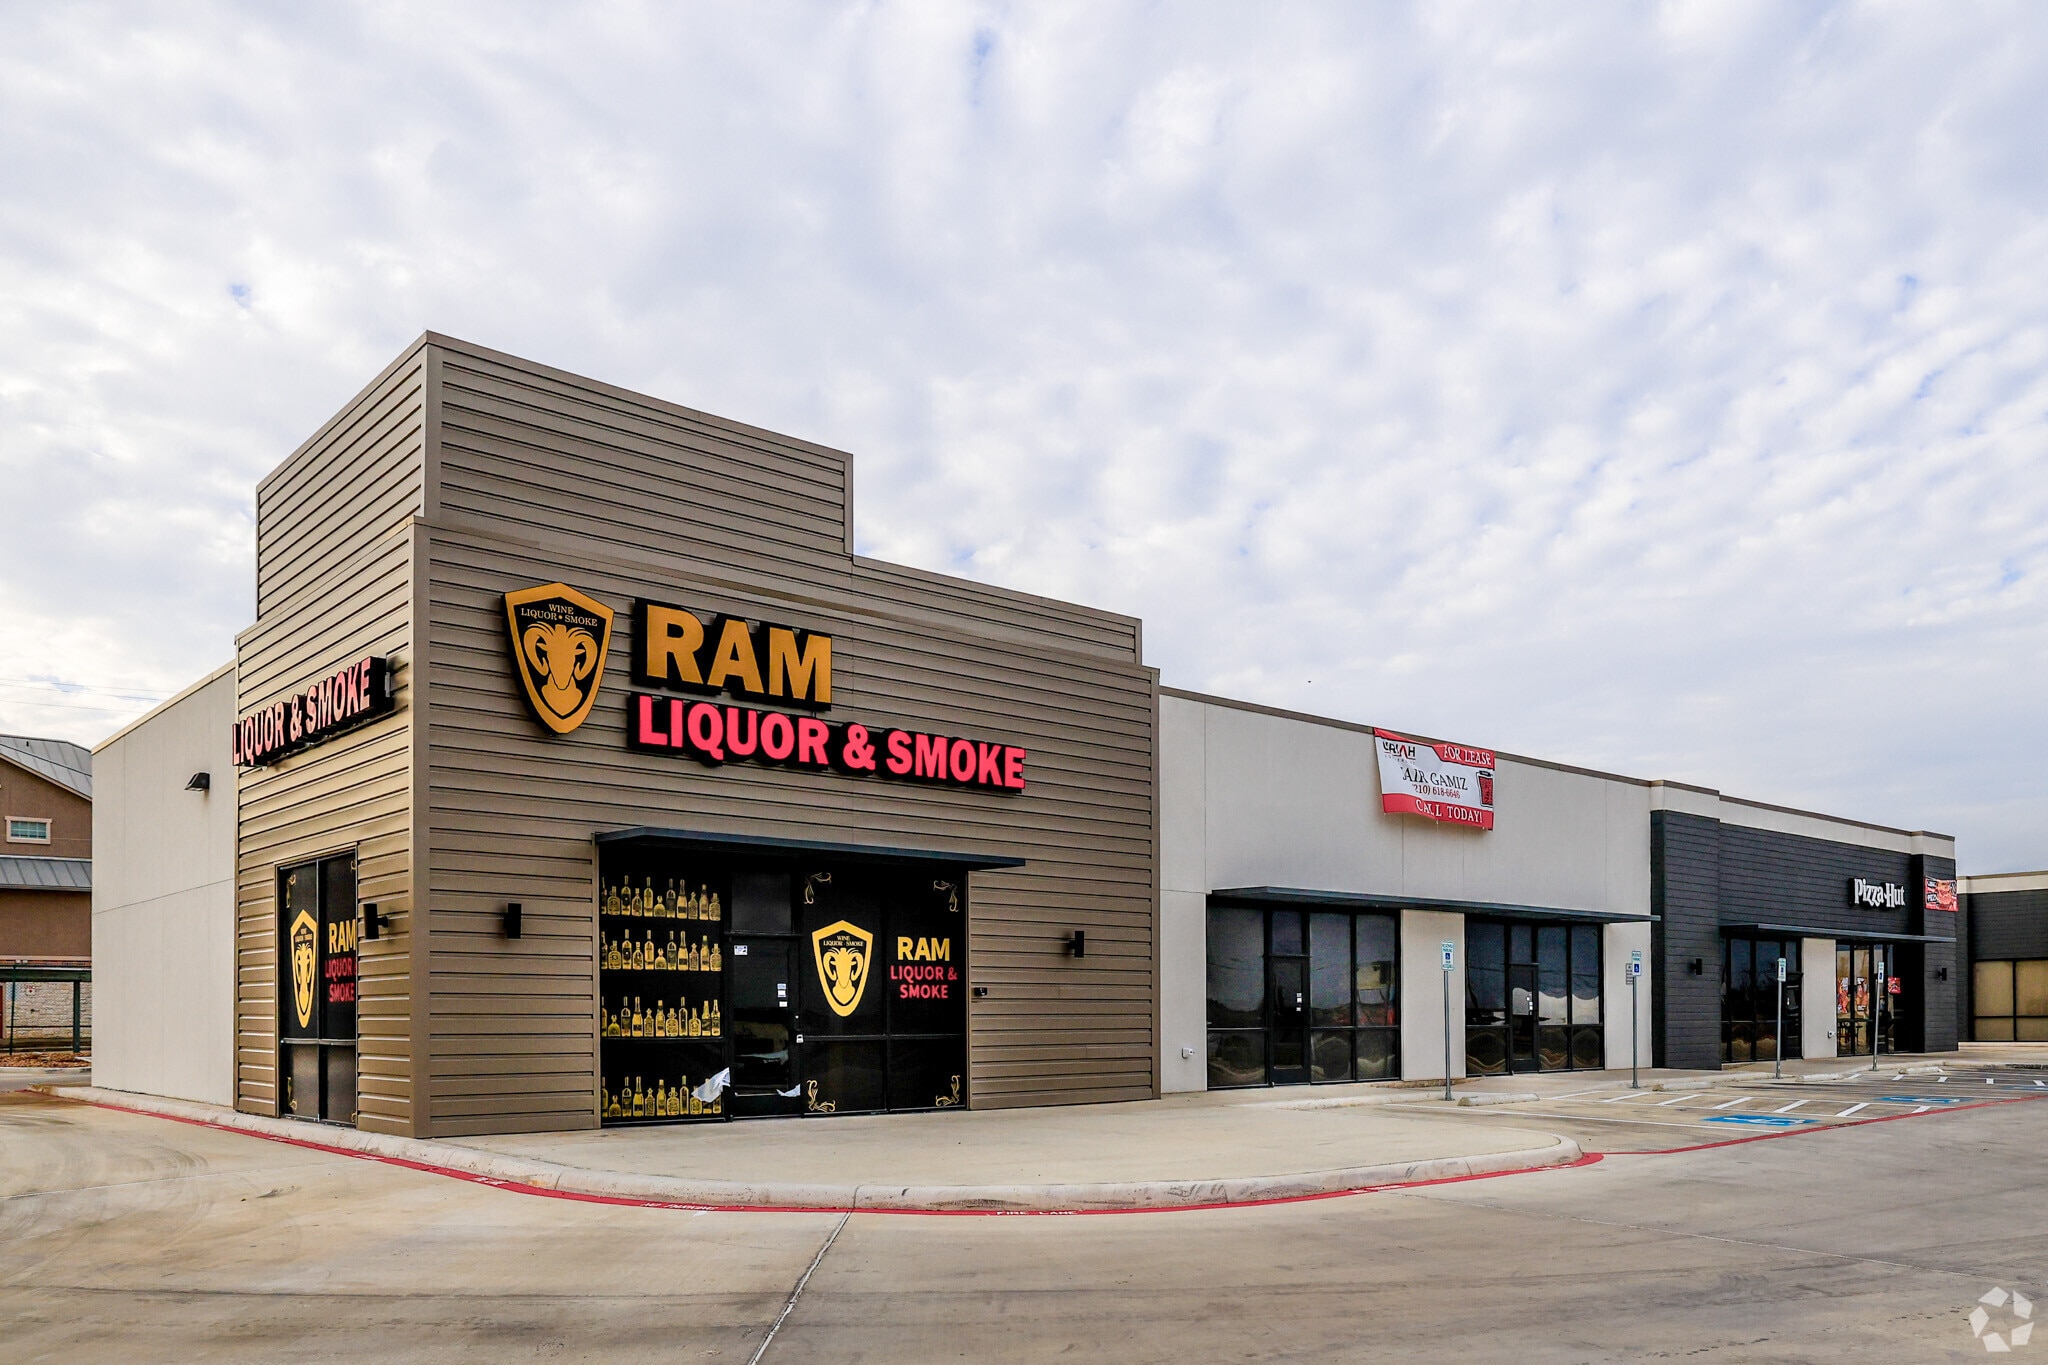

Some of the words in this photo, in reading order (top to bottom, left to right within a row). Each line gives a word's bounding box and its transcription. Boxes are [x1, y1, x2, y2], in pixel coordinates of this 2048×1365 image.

[520, 607, 558, 621] LIQUOR
[564, 614, 598, 627] SMOKE
[548, 603, 575, 615] WINE
[646, 603, 832, 703] RAM
[231, 702, 285, 767] LIQUOR
[289, 694, 303, 743] &
[305, 656, 373, 735] SMOKE
[638, 695, 831, 766] LIQUOR
[842, 723, 877, 772] &
[886, 729, 1026, 790] SMOKE
[1443, 745, 1462, 762] FOR
[1464, 749, 1492, 766] LEASE
[1400, 766, 1428, 784] AIR
[1430, 772, 1468, 791] GAMIZ
[1412, 784, 1431, 796] 210)
[1415, 799, 1442, 817] CALL
[1447, 805, 1483, 823] TODAY!
[1854, 878, 1885, 907] Pizza
[1884, 882, 1906, 908] Hut
[328, 918, 356, 954] RAM
[897, 936, 950, 962] RAM
[324, 957, 353, 982] LIQUOR
[890, 965, 944, 984] LIQUOR
[947, 966, 958, 981] &
[328, 982, 355, 1003] SMOKE
[899, 984, 949, 999] SMOKE
